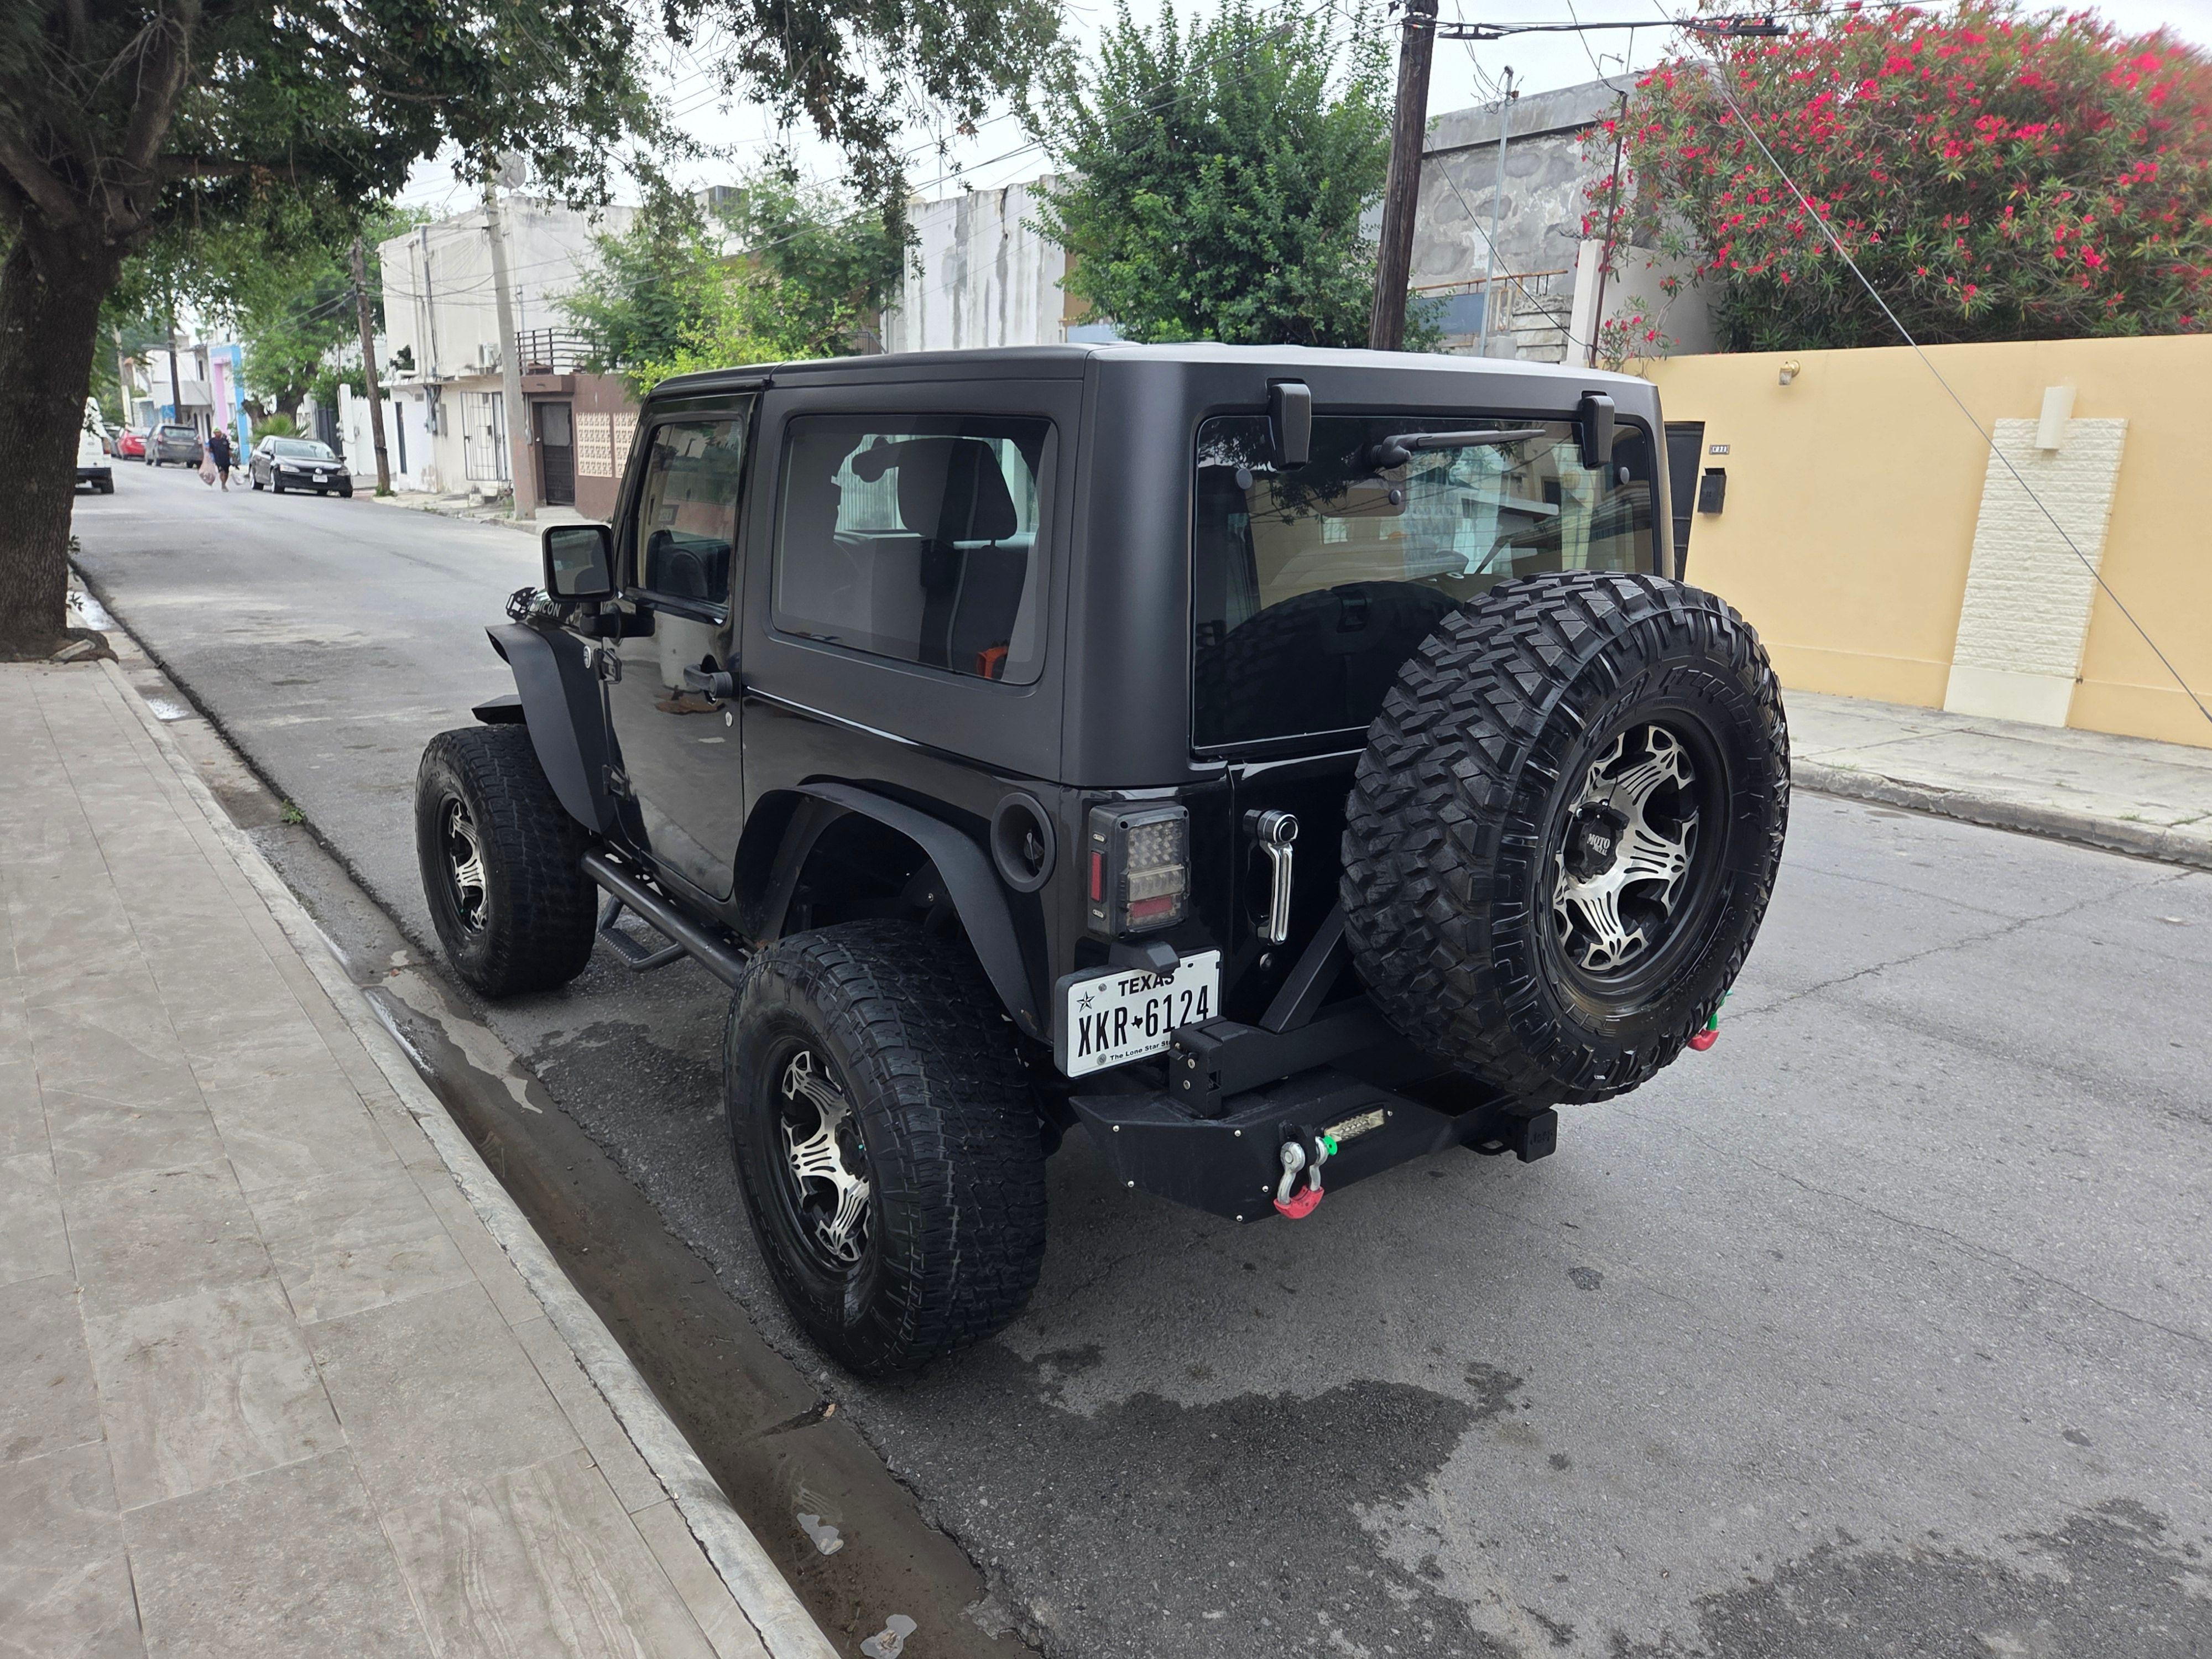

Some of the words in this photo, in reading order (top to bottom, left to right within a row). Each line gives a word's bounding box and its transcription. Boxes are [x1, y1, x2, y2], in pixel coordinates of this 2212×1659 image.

[1587, 833, 1610, 849] MOTO
[1118, 974, 1175, 997] TEXAS
[1078, 1006, 1128, 1058] XKR
[1145, 985, 1208, 1037] 6124
[1125, 1048, 1142, 1057] Lone
[1145, 1043, 1159, 1052] Star
